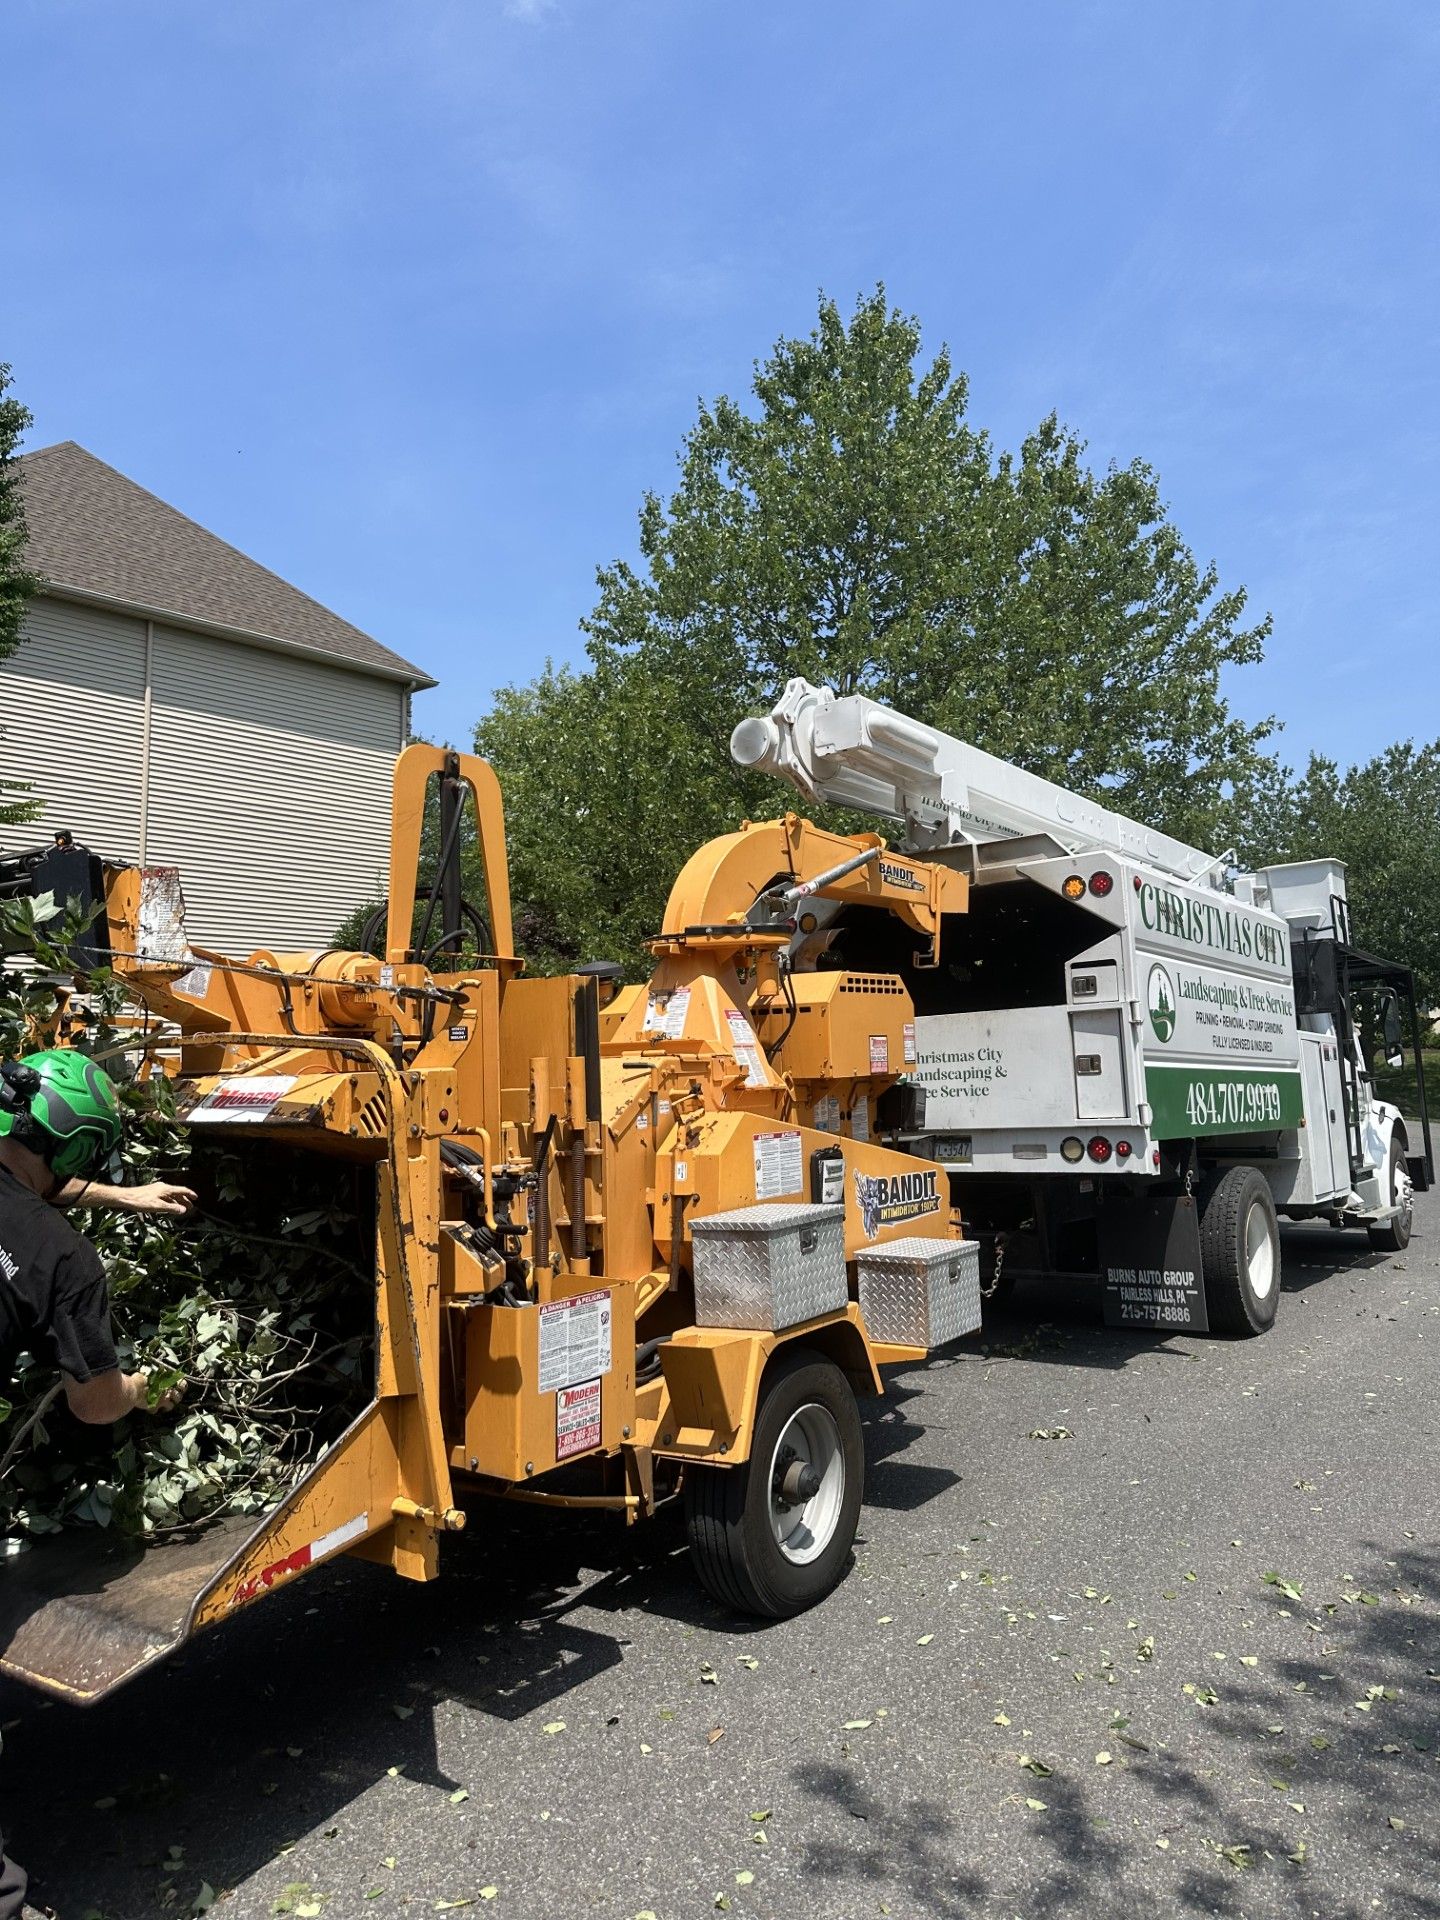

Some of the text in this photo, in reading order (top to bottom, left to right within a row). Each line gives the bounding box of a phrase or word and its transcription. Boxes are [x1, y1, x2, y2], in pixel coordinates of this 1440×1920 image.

[879, 863, 914, 881] BANDIT
[1140, 883, 1287, 966] CHRISTMAS CITY
[1177, 972, 1293, 1016] Landscaping & Tree Service
[1196, 1011, 1284, 1034] PRUNING REMOVAL STUMP GRINDING
[1212, 1035, 1228, 1048] FULLY
[1228, 1037, 1250, 1051] LICENSED
[1254, 1040, 1273, 1052] INSURED
[917, 1047, 1003, 1064] hristmas City
[995, 1065, 1008, 1078] &
[212, 1088, 284, 1109] MODERN
[925, 1084, 990, 1098] ee Service
[1186, 1082, 1281, 1125] 484.707.9949
[877, 1171, 937, 1207] BANDIT
[881, 1204, 919, 1219] INTIMIDATOR
[1107, 1268, 1195, 1286] BURNS AUTO GROUP
[548, 1293, 605, 1311] DANGER PELIGRO
[1120, 1287, 1152, 1301] FAIRLESS
[1176, 1290, 1187, 1304] PA
[1121, 1304, 1191, 1322] 215-757-8886
[564, 1384, 600, 1408] MODERN
